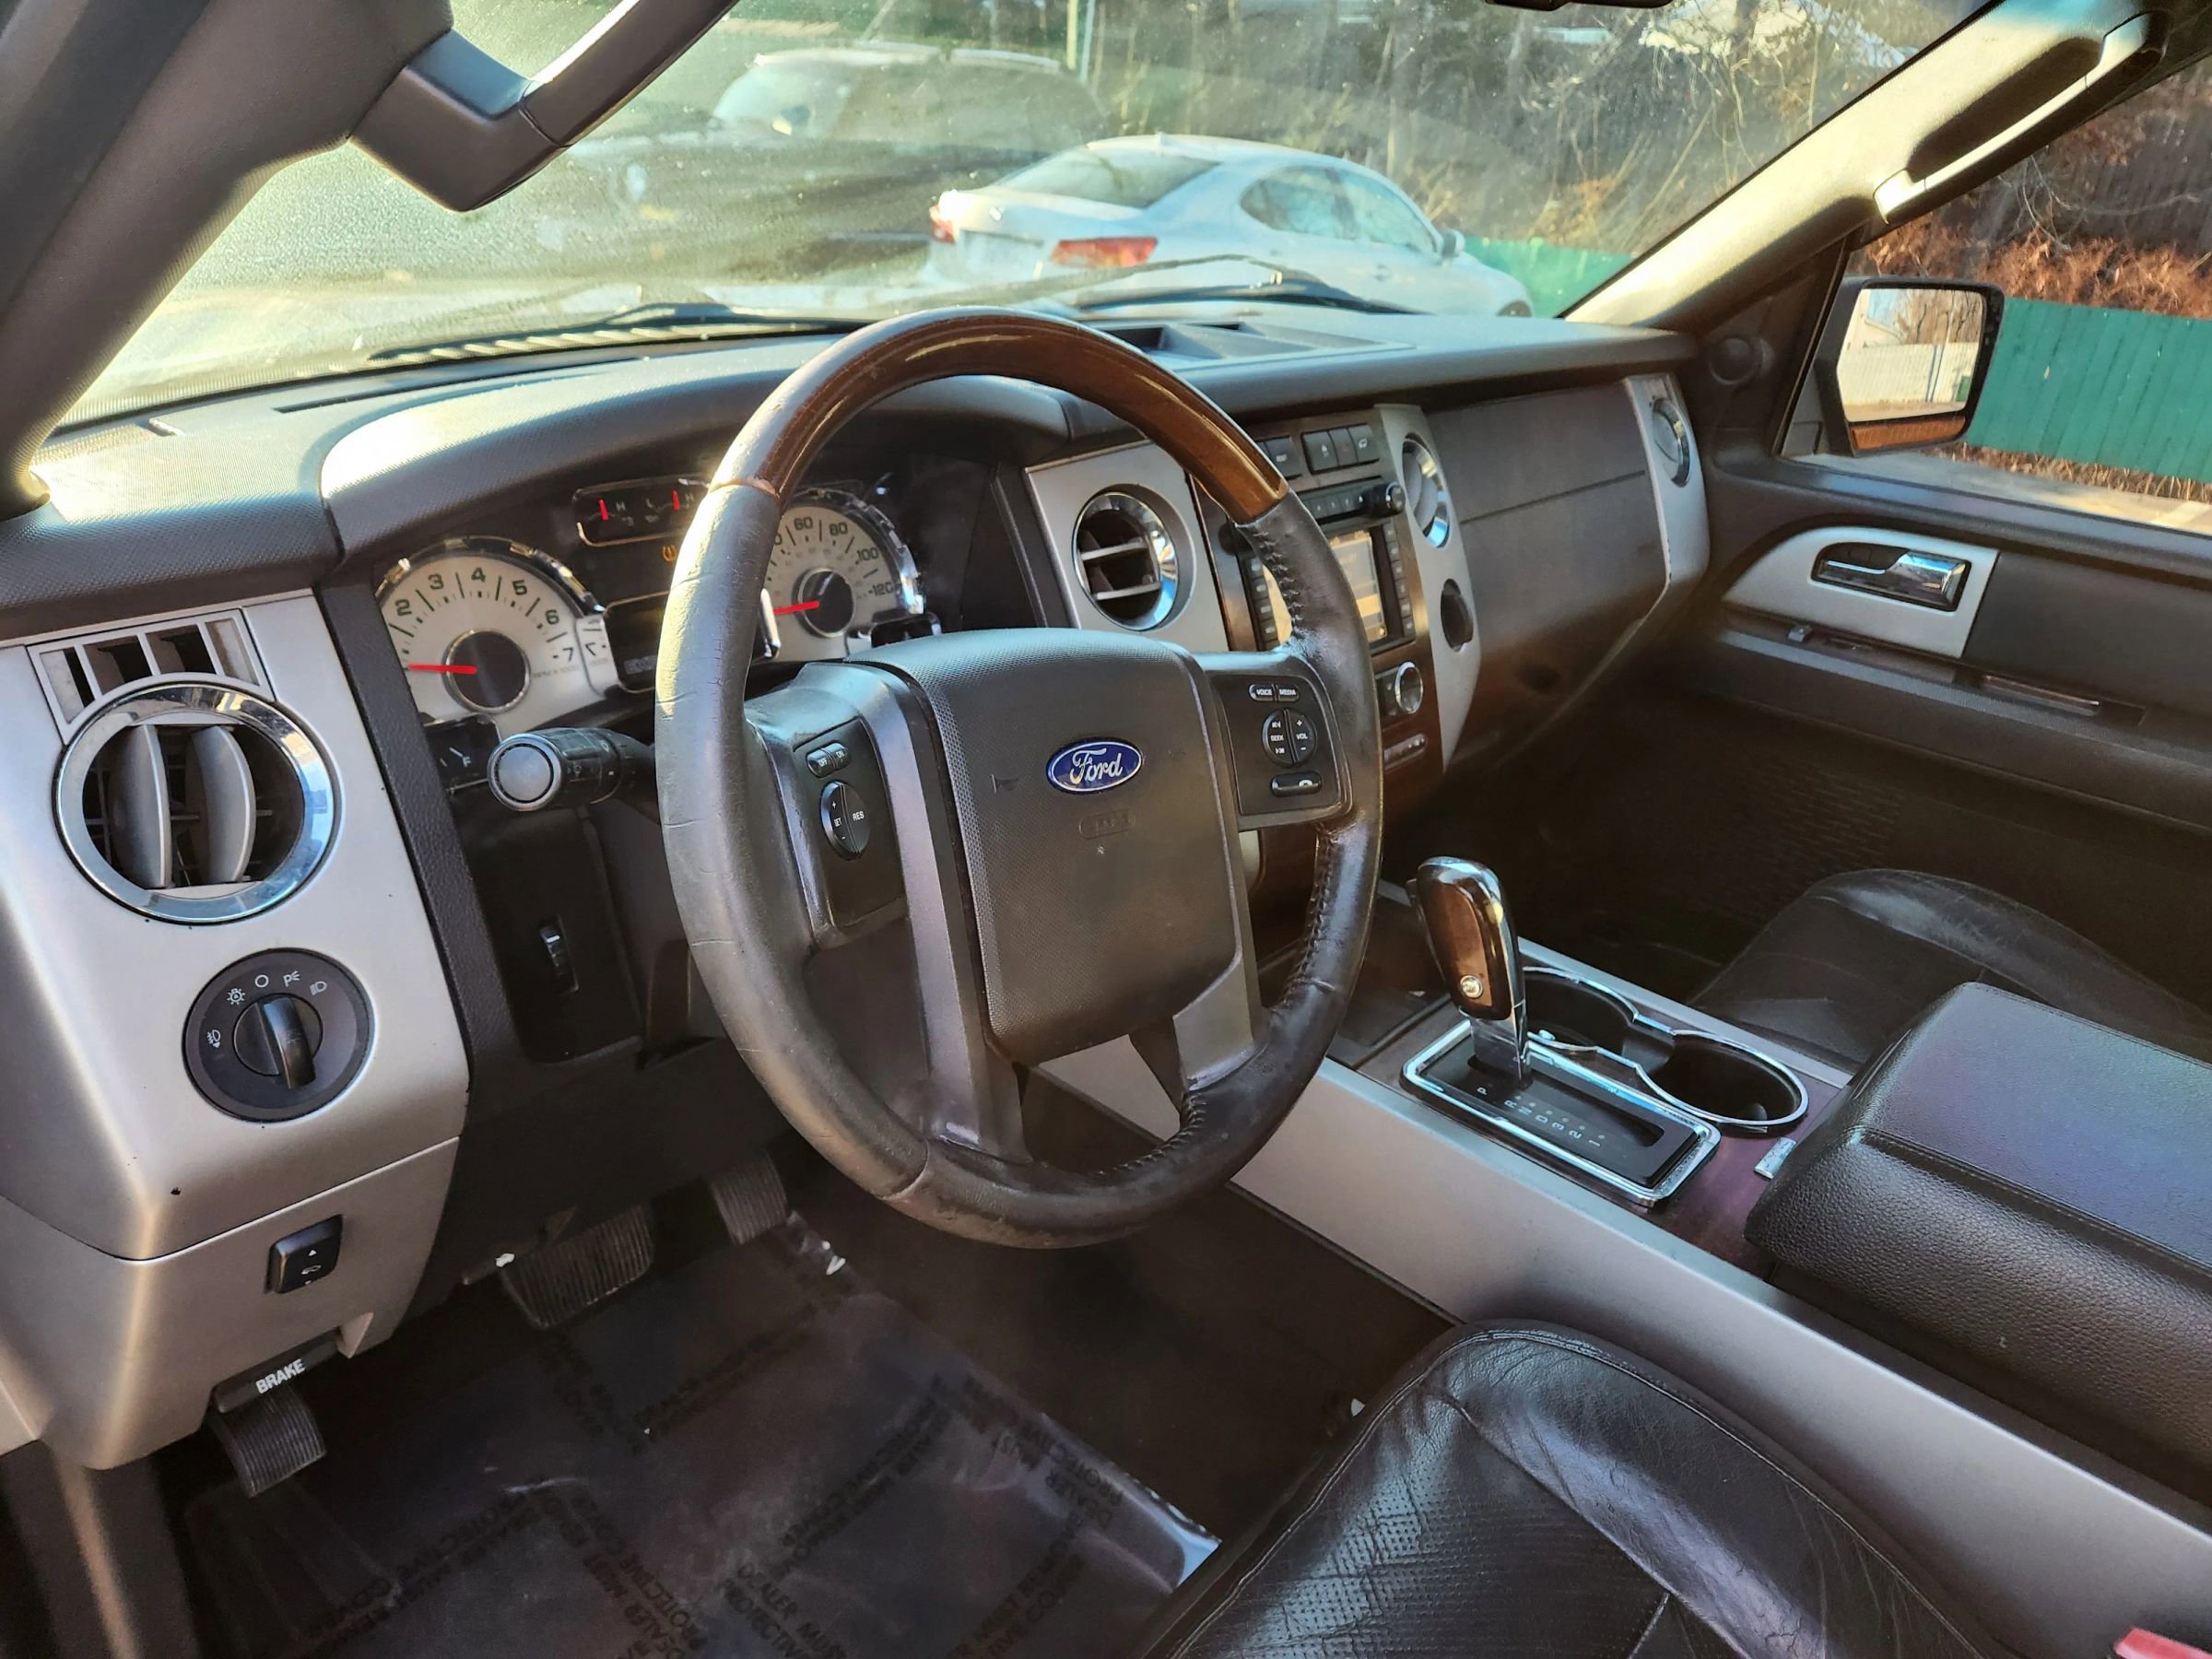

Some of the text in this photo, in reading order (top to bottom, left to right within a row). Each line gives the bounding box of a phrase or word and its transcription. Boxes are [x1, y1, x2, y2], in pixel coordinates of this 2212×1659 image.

[794, 516, 813, 530] 60
[830, 522, 848, 535] 80
[857, 547, 878, 561] 100
[428, 573, 444, 590] 3
[471, 567, 486, 582] 4
[512, 580, 527, 595] 5
[872, 582, 893, 595] 120
[395, 599, 411, 617] 2
[545, 609, 559, 625] 6
[562, 647, 573, 662] 7
[1270, 734, 1285, 742] SEEK
[835, 749, 845, 759] ON
[818, 757, 828, 768] OFF
[1069, 747, 1124, 784] Ford
[833, 818, 842, 828] SET
[852, 811, 865, 821] RES
[1569, 1130, 1583, 1139] 2
[255, 1359, 305, 1394] BRAKE
